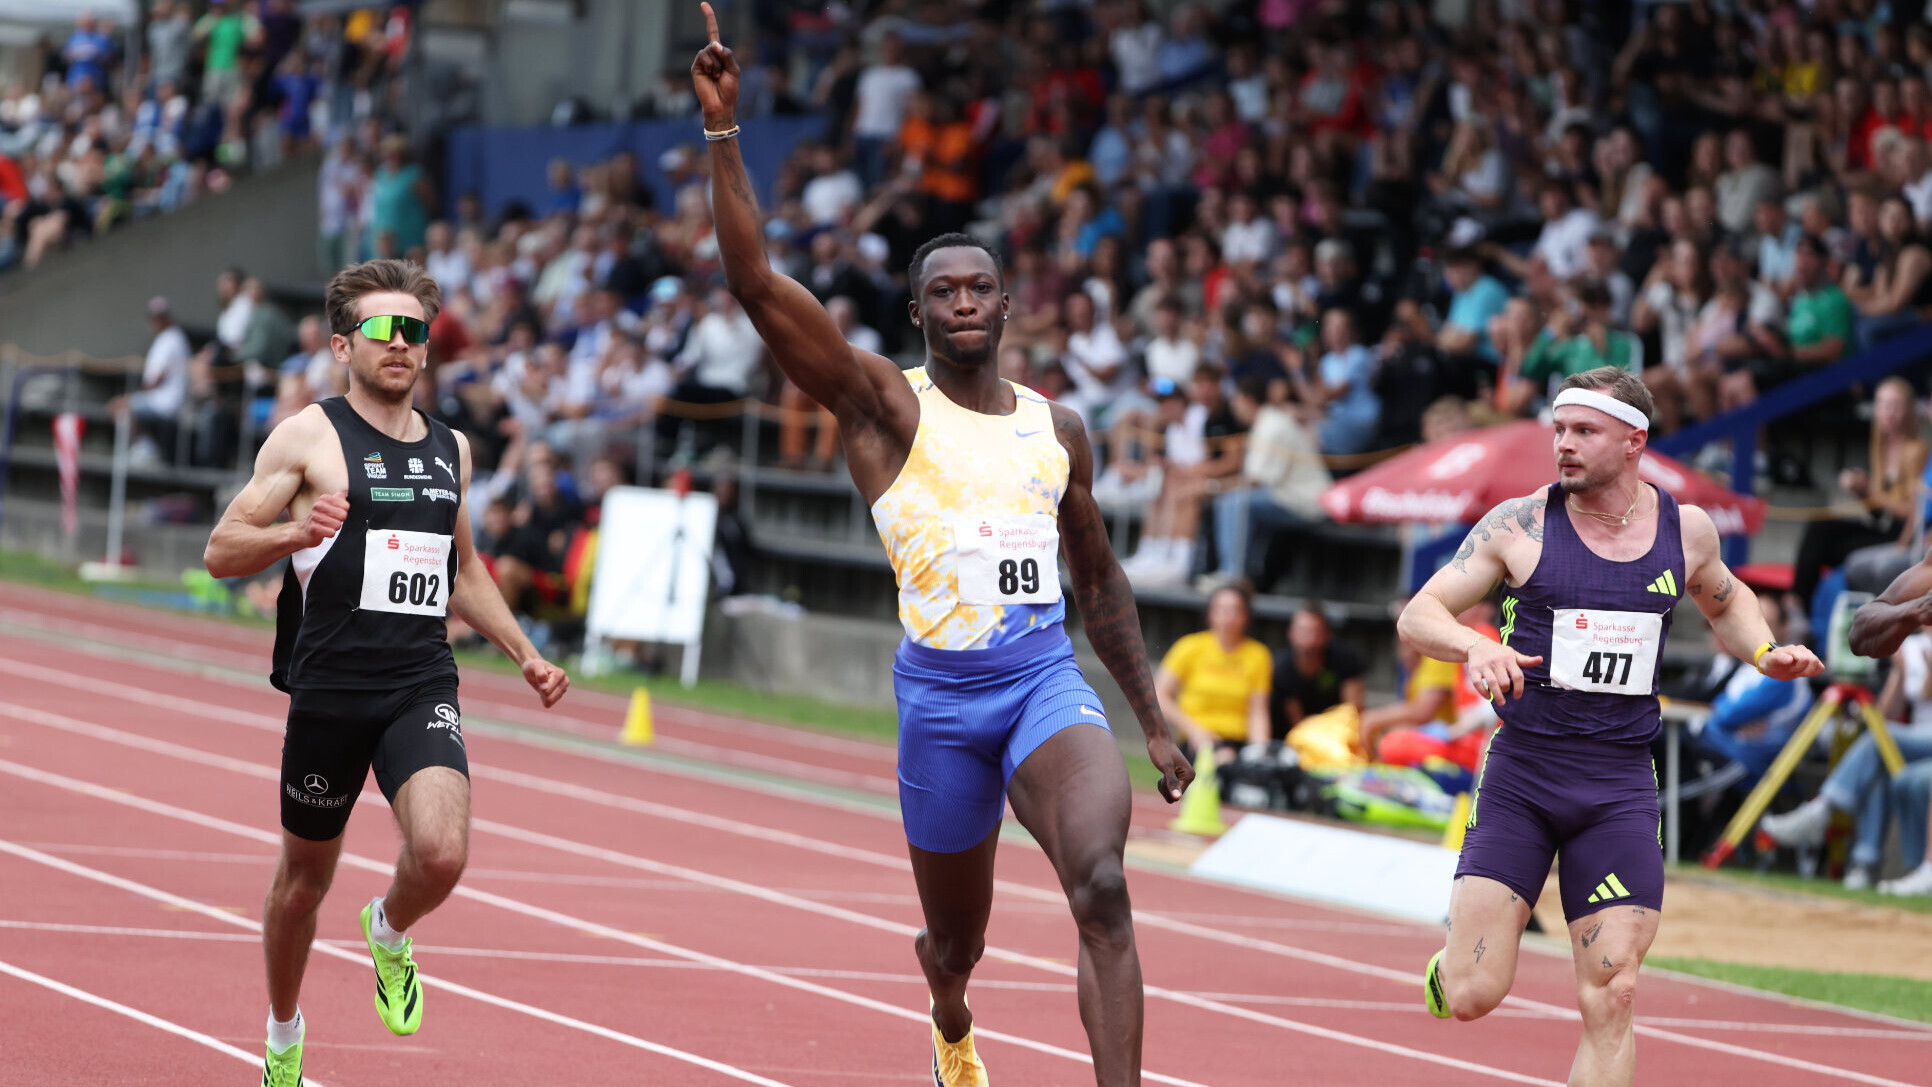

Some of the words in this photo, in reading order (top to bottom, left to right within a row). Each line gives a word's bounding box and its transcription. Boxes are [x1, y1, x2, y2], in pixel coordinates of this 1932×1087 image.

[365, 467, 387, 475] TEAM
[999, 558, 1039, 595] 89
[389, 571, 440, 607] 602
[1593, 622, 1636, 633] Sparkasse
[1593, 634, 1643, 646] Regensburg
[1582, 651, 1633, 686] 477
[426, 720, 462, 737] WETZL
